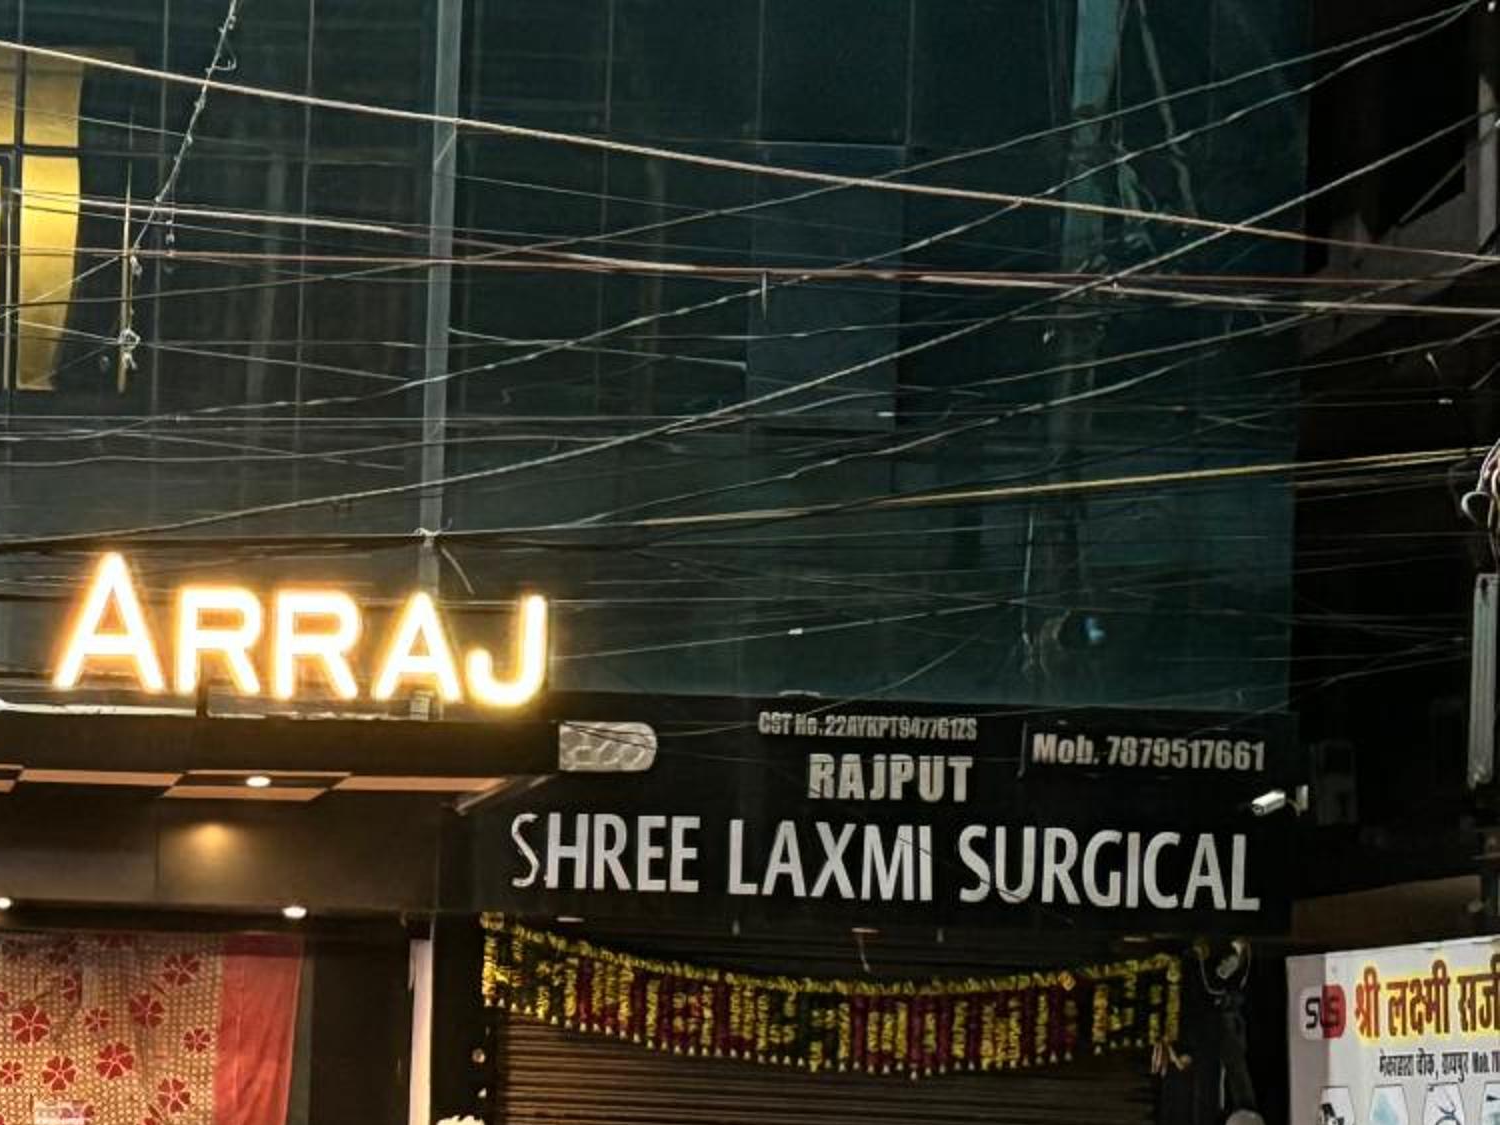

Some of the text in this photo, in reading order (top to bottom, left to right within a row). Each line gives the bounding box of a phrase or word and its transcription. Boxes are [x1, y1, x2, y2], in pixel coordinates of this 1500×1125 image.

[52, 551, 547, 707] ARRAJ
[808, 753, 974, 802] RAJPUT
[1032, 733, 1265, 771] Mob. 7879517661
[511, 812, 1261, 911] SHREE LAXMI SURGICAL
[1355, 966, 1380, 1038] श्री
[1386, 959, 1450, 1036] लक्ष्मी
